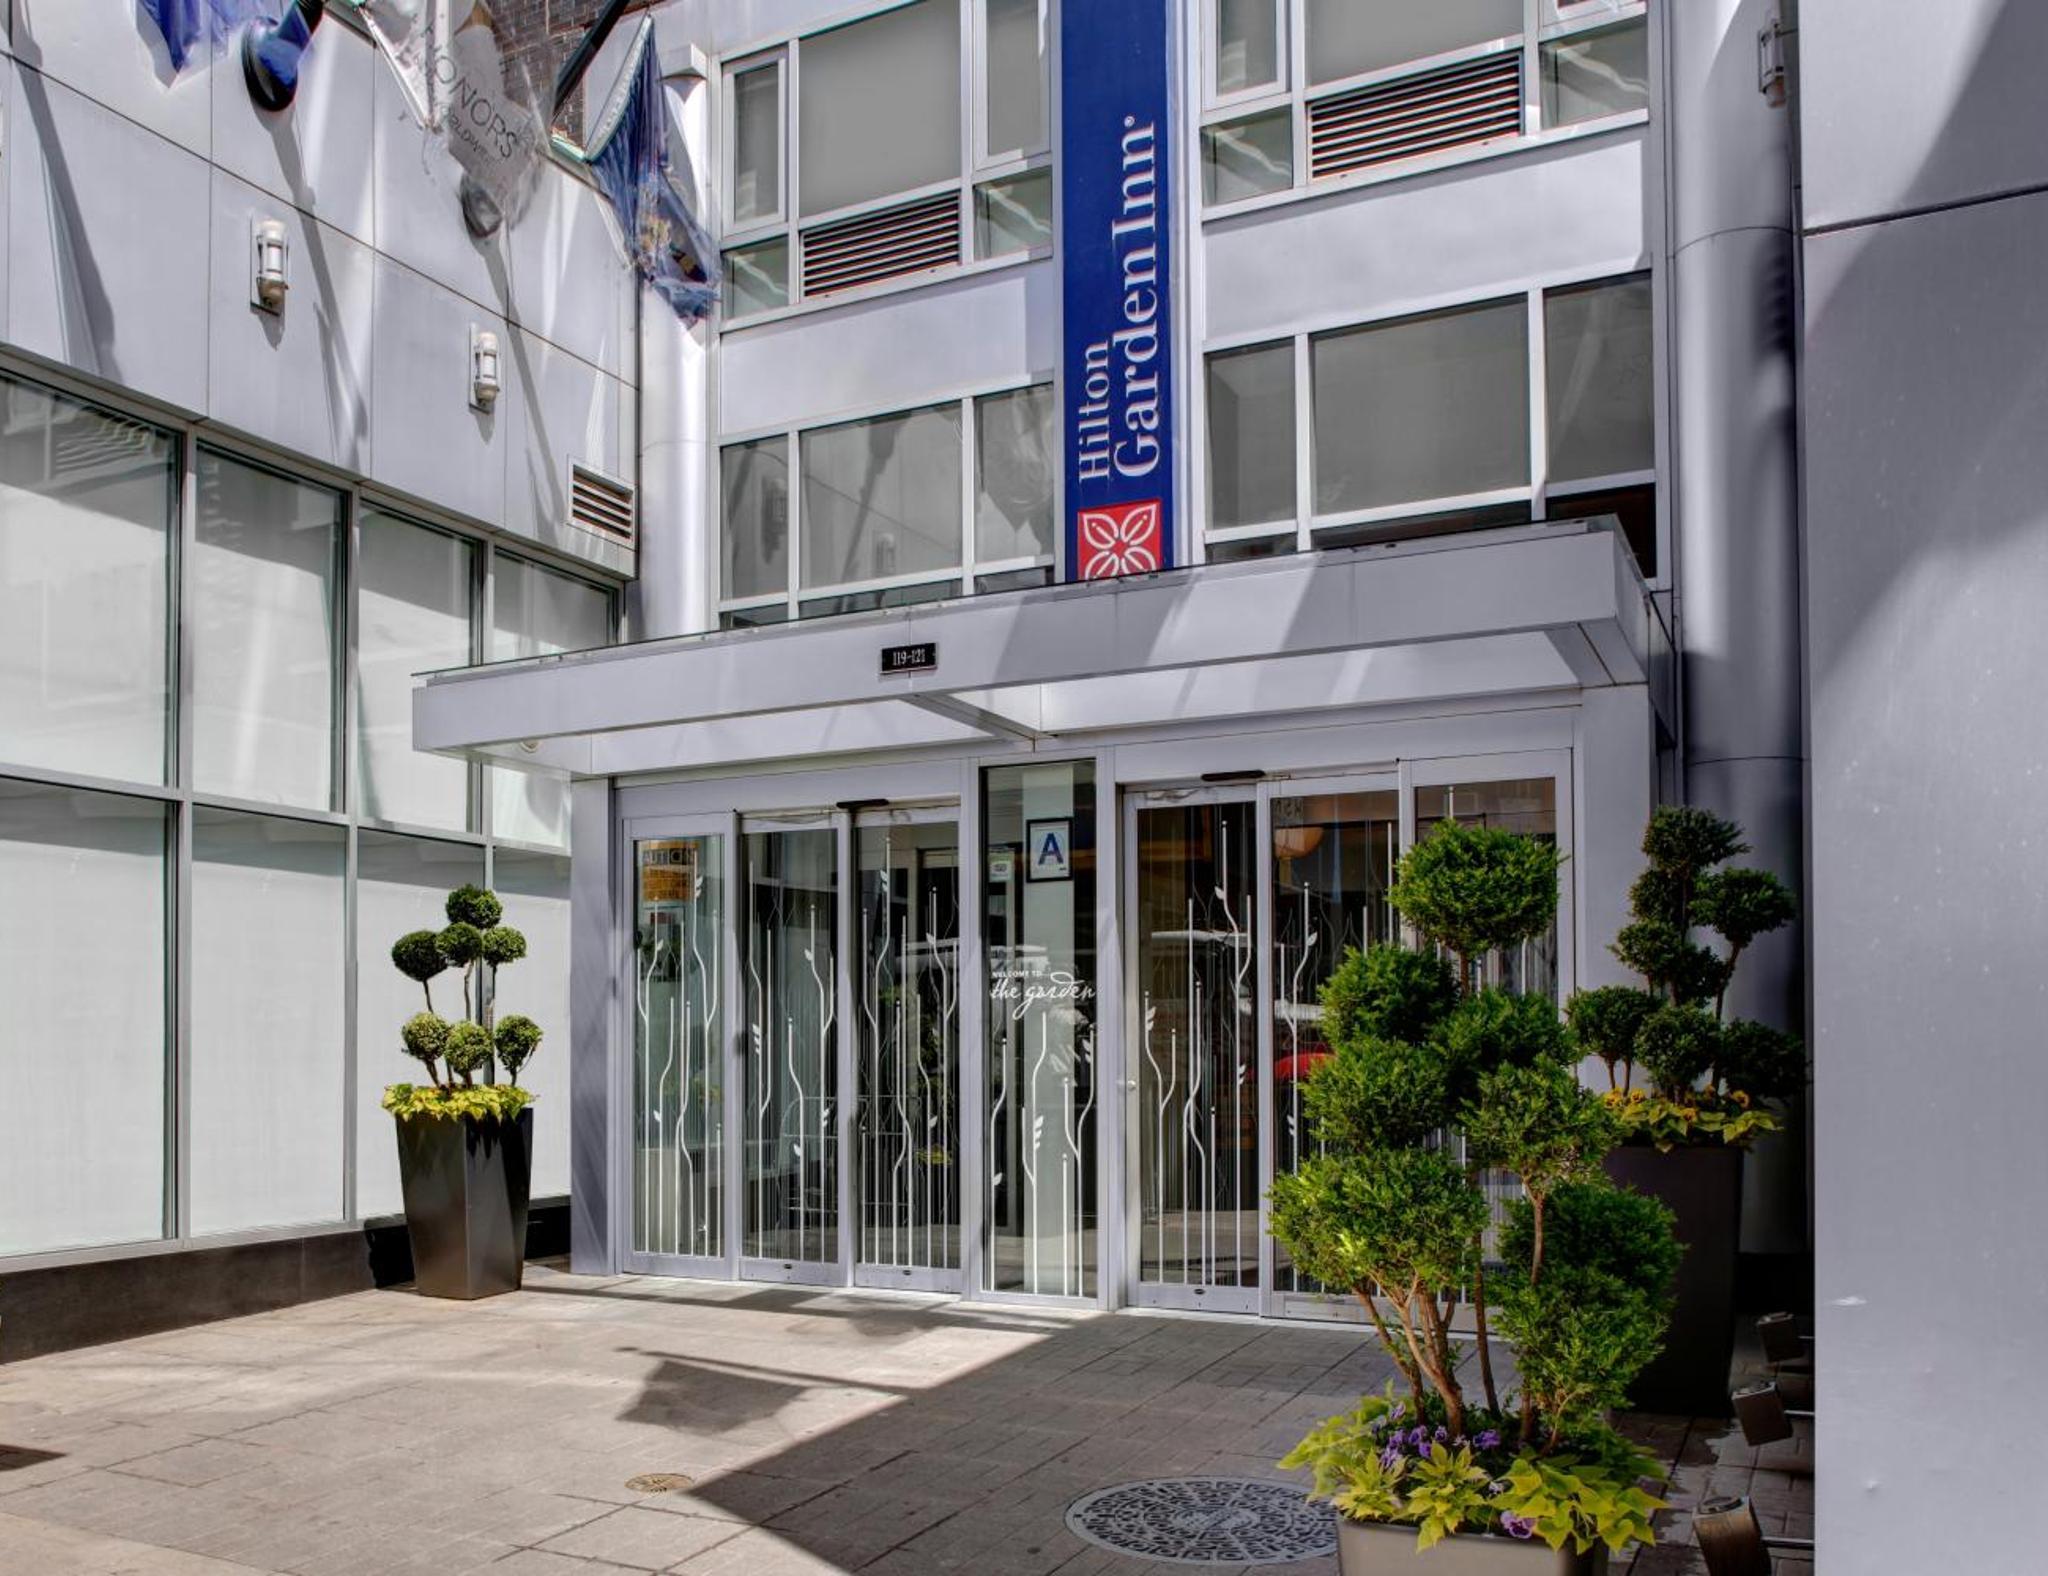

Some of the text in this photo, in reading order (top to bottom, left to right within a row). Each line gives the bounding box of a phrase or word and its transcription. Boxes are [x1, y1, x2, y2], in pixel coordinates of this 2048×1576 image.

[1112, 243, 1161, 477] Garden
[1079, 340, 1110, 485] Hilton
[892, 648, 926, 667] 119-121
[642, 848, 695, 866] AUTION
[1038, 832, 1064, 866] A
[991, 970, 1030, 979] WELCOME
[989, 971, 1096, 1020] the garden
